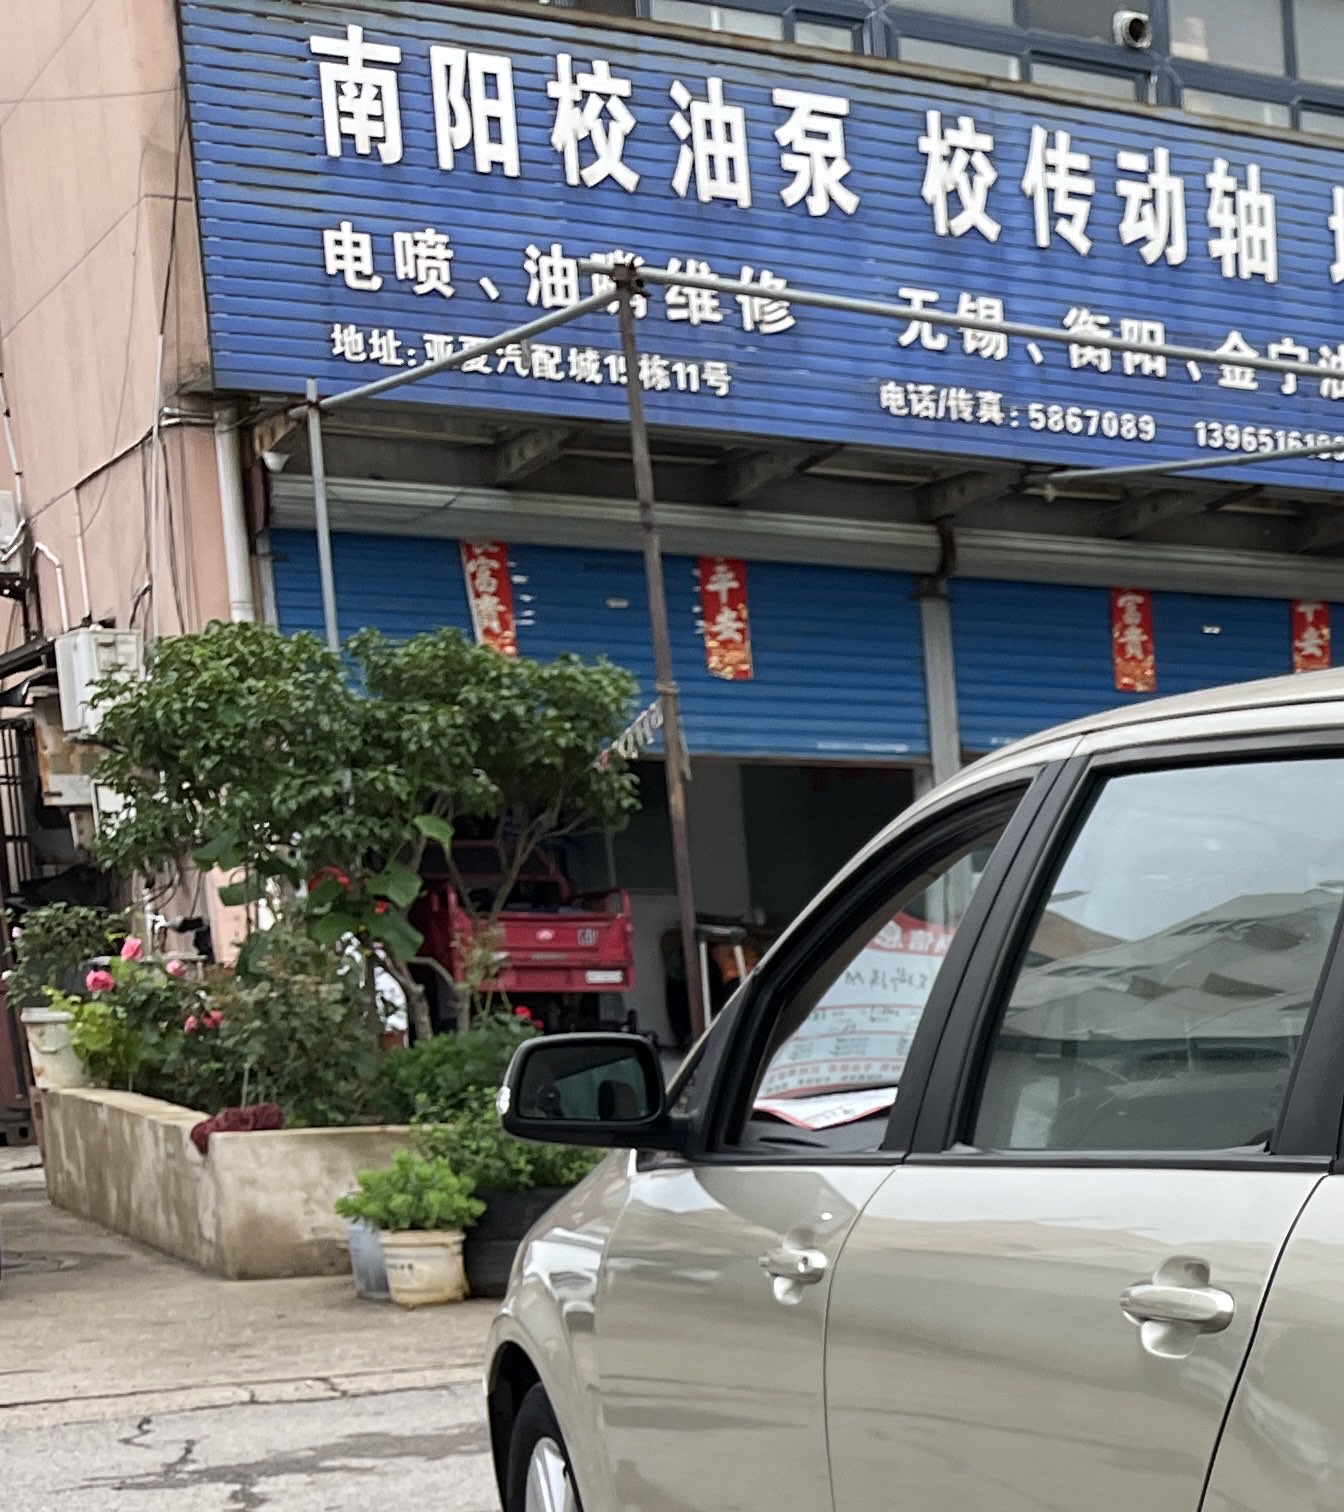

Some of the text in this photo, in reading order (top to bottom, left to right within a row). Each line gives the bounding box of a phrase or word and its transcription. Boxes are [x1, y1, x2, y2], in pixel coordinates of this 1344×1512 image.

[310, 25, 860, 217] 南阳校油泵
[917, 111, 1279, 283] 校传动轴
